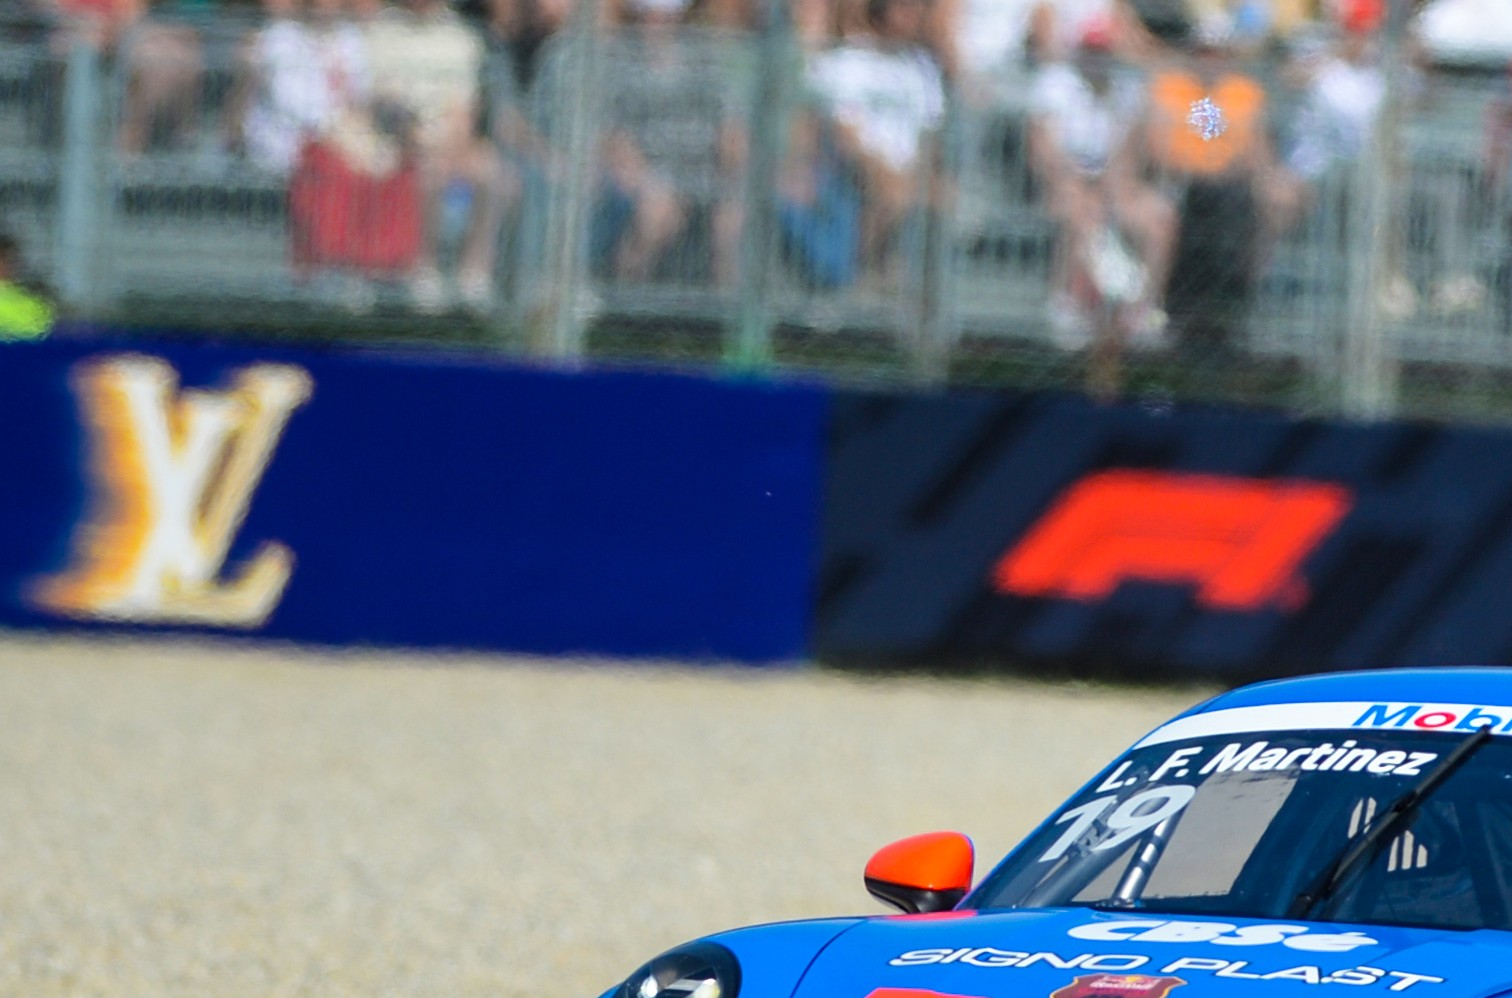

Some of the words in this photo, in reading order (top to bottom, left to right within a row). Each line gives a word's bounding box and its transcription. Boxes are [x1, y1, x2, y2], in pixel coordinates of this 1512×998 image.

[1095, 760, 1138, 794] L.
[1148, 745, 1203, 783] F.
[1197, 740, 1438, 777] Martinez
[1037, 784, 1197, 864] 19
[889, 946, 1151, 971] SIGNO
[1160, 956, 1445, 992] PLAST
